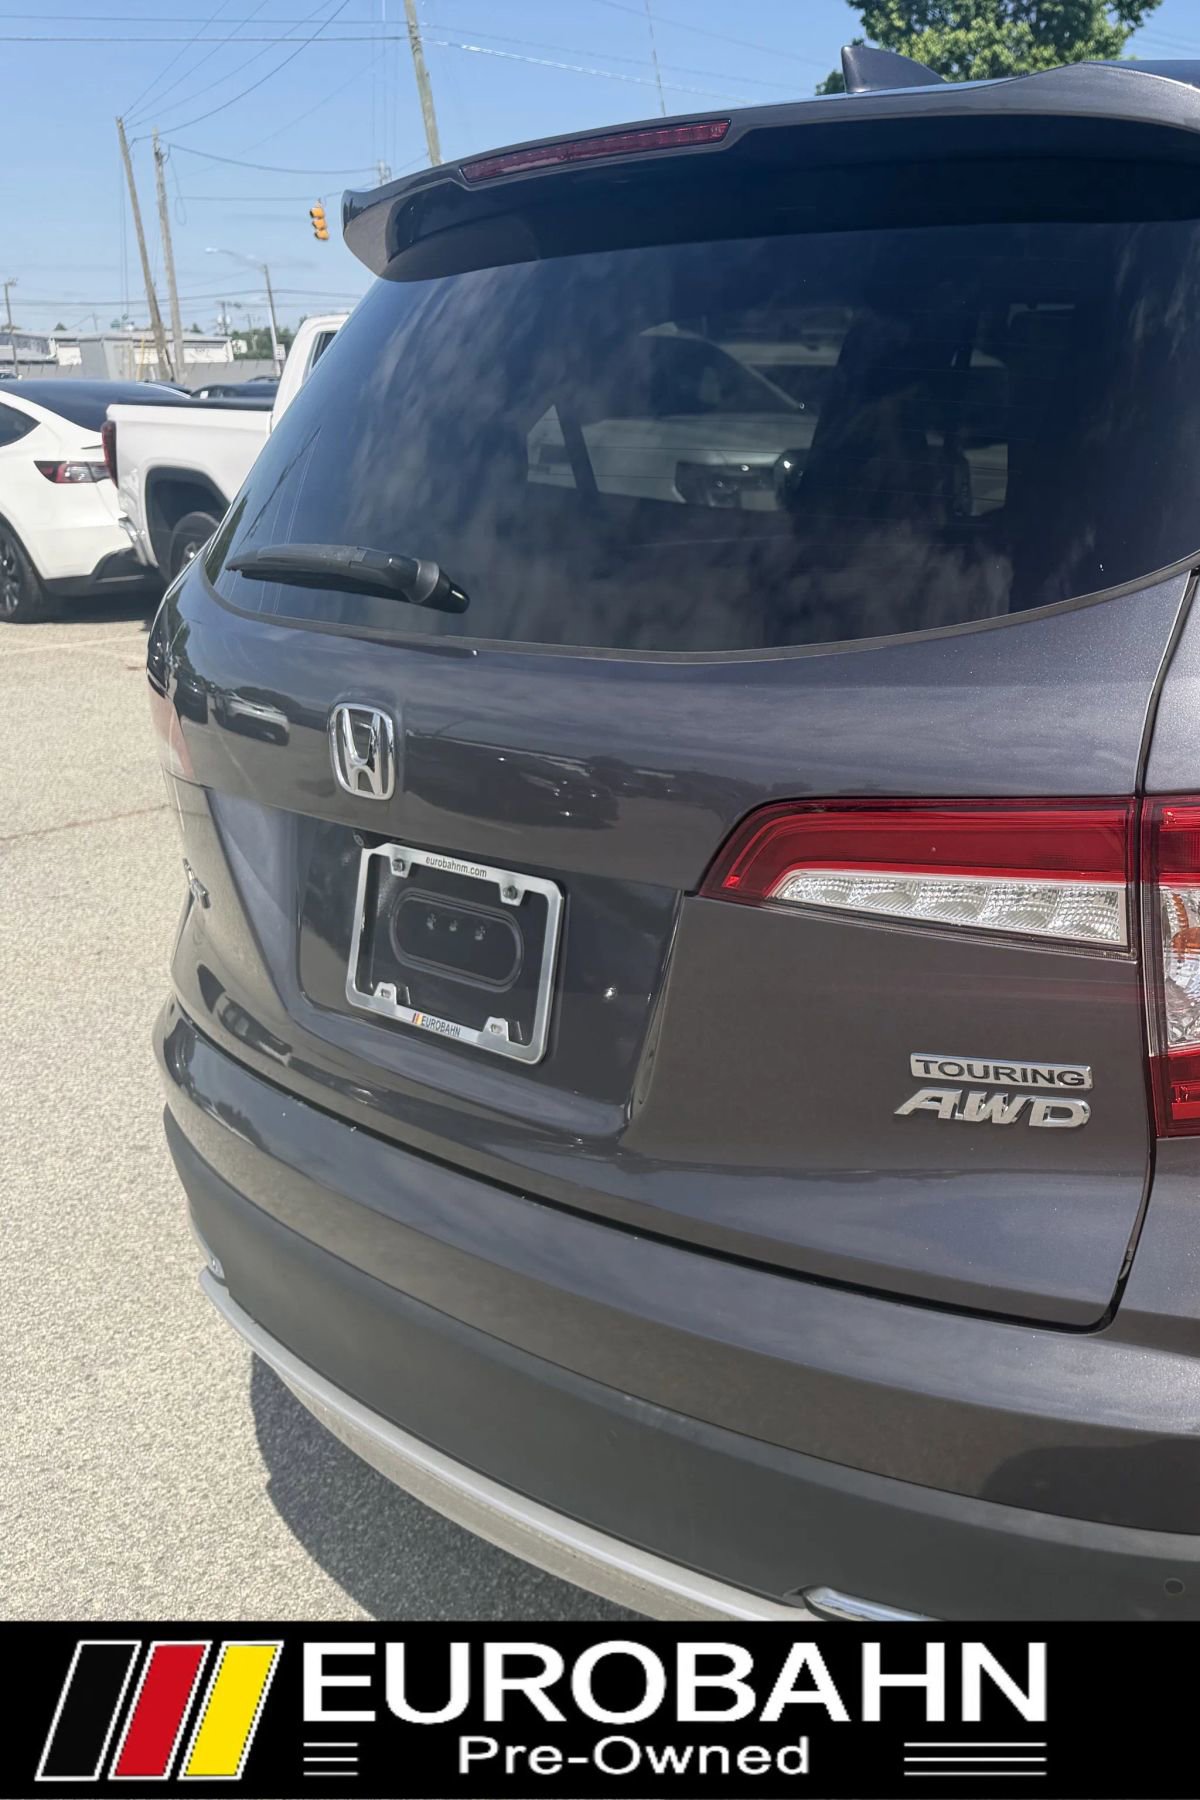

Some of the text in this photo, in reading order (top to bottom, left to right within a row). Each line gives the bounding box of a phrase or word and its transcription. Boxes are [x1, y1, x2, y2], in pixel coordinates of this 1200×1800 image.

[425, 856, 487, 878] eurobahnm.com
[421, 1015, 461, 1037] EUROBAHN
[915, 1059, 1085, 1086] TOURING
[894, 1087, 1091, 1127] AWD
